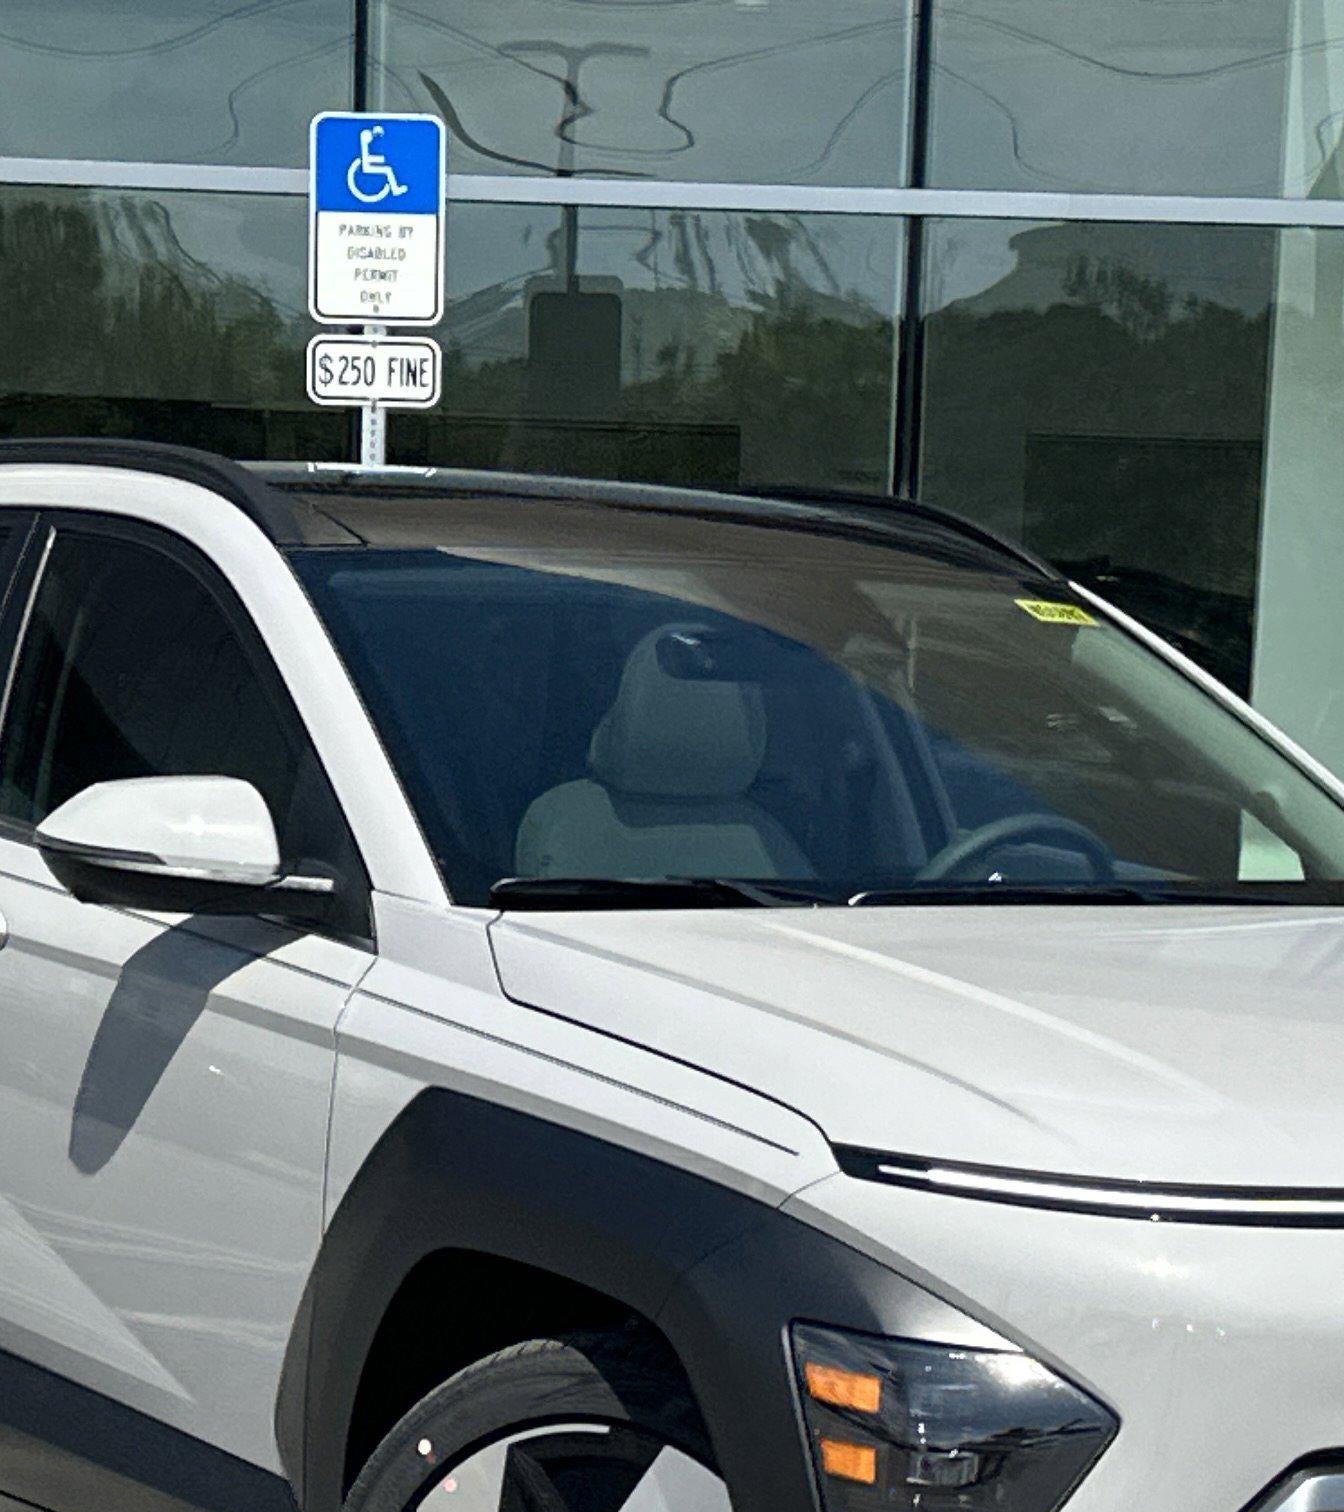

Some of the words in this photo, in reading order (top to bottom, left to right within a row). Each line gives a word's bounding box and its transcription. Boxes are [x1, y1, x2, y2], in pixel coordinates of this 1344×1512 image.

[338, 223, 393, 239] PARKING
[347, 245, 407, 262] DISABLED
[354, 267, 399, 283] PERMIT
[359, 289, 392, 304] ONLY
[318, 353, 376, 387] $250
[387, 356, 430, 388] FINE
